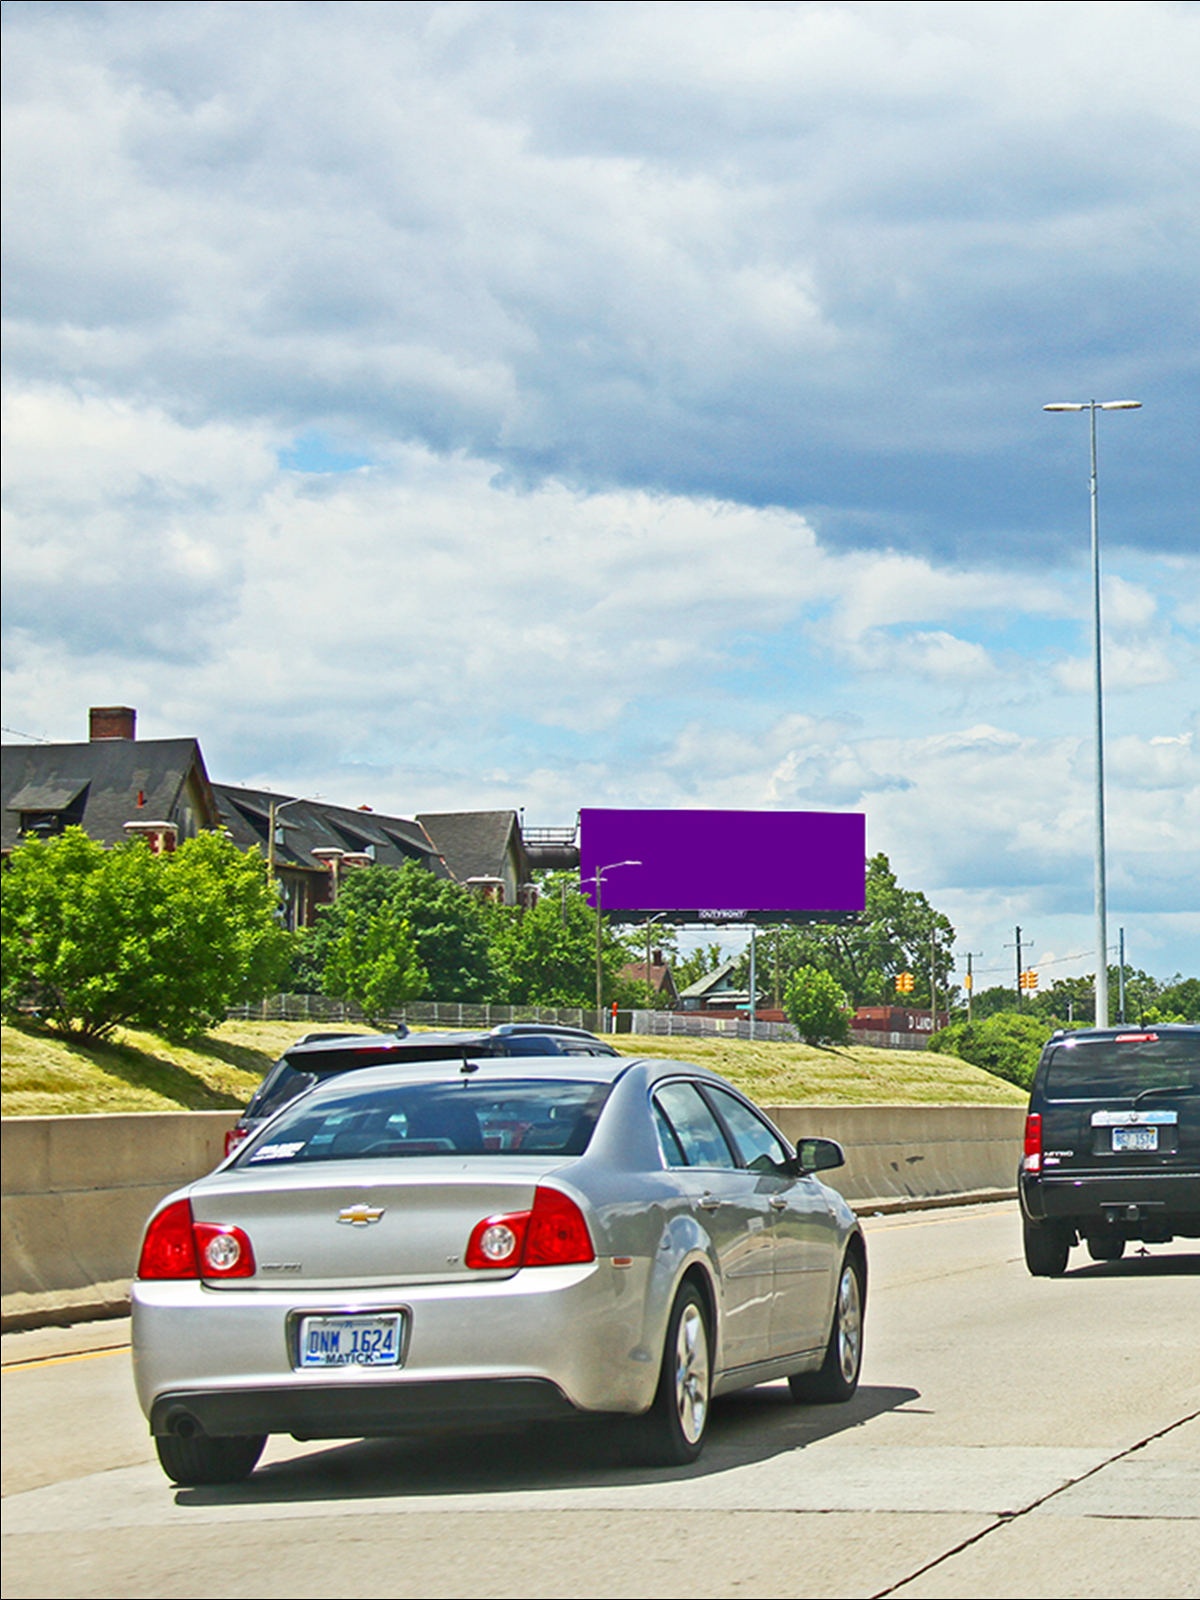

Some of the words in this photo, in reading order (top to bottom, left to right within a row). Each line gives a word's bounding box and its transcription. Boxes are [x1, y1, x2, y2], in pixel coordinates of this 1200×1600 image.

[310, 1331, 340, 1354] DNM
[350, 1329, 393, 1353] 1624
[326, 1353, 374, 1364] MATICK
